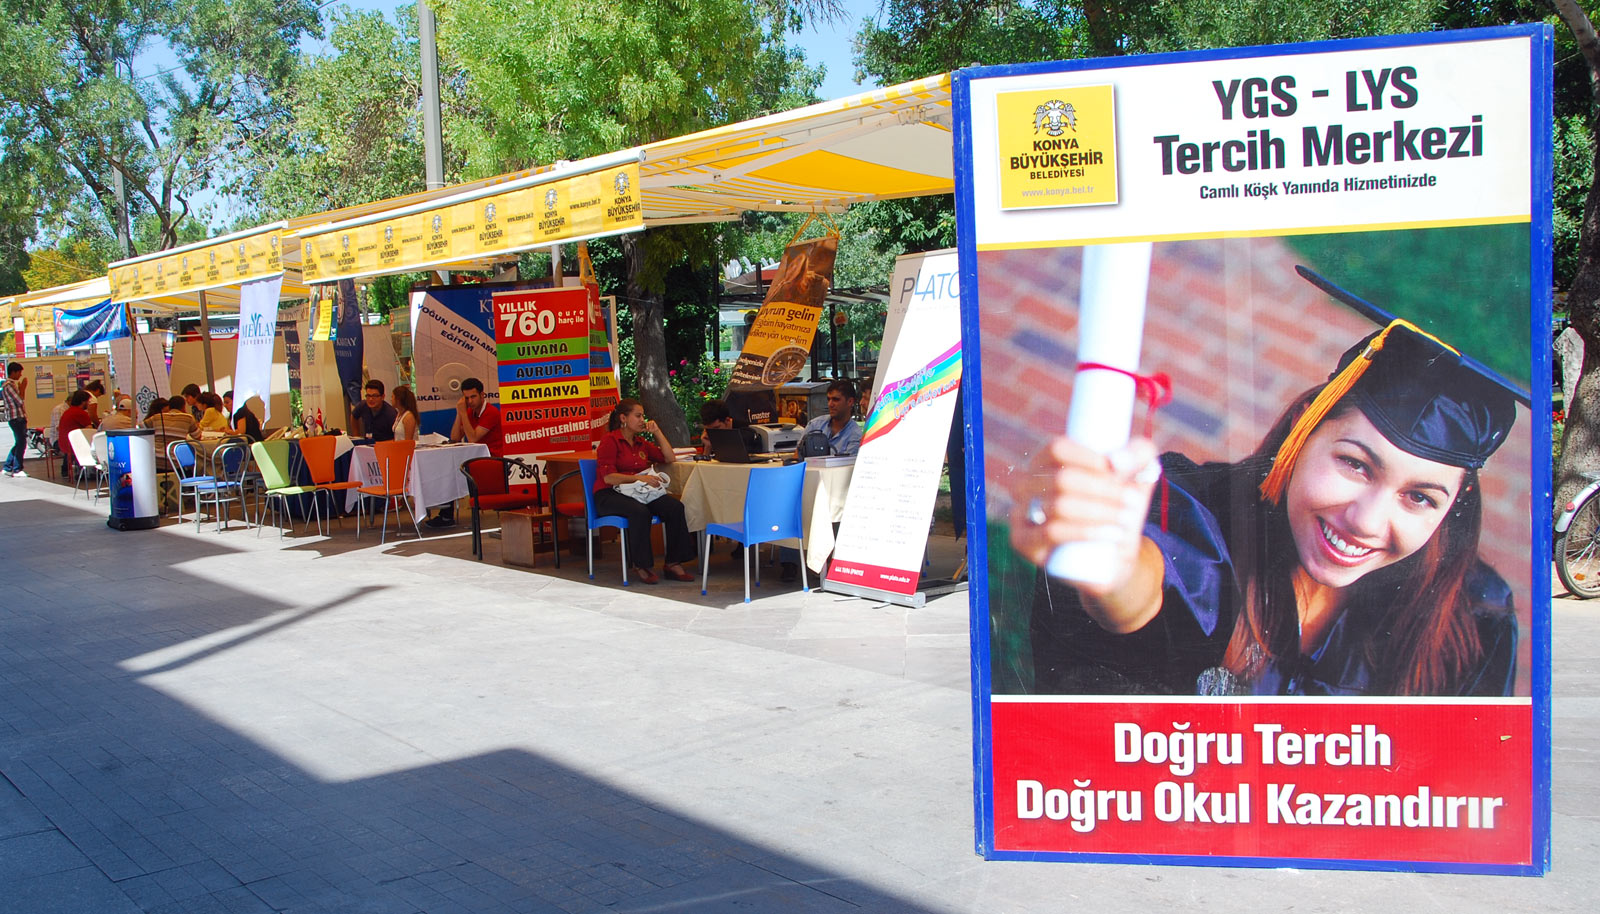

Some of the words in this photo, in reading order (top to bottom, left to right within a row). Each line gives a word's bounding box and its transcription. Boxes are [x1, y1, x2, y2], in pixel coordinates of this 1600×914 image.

[1212, 75, 1297, 120] YGS
[1346, 66, 1418, 112] LYS
[1033, 138, 1079, 151] KONYA
[1153, 129, 1285, 175] Tercih
[1302, 114, 1483, 167] Merkezi
[1010, 148, 1103, 170] BÜYÜKŞEHİR
[1030, 168, 1085, 180] BELEDİYESİ
[1022, 185, 1095, 198] www.konya.bel.tr
[1200, 185, 1239, 199] Camlı
[1244, 182, 1278, 200] Köşk
[1282, 179, 1339, 195] Yanında
[1344, 173, 1437, 191] Hizmetinizde
[498, 301, 537, 313] YILLIK
[786, 308, 815, 321] gelin
[500, 310, 555, 337] 760
[558, 317, 574, 325] harç
[440, 330, 475, 352] EĞİTİM
[516, 364, 572, 378] AVRUPA
[511, 384, 579, 400] ALMANYA
[506, 406, 587, 422] AVUSTURYA
[505, 420, 590, 444] ÜNİVERSİTELERİNDE
[1114, 721, 1243, 776] Doğru
[1253, 723, 1392, 766] Tercih
[1016, 779, 1142, 833] Doğru
[1154, 781, 1250, 824] Okul
[1266, 783, 1503, 829] Kazandırır
